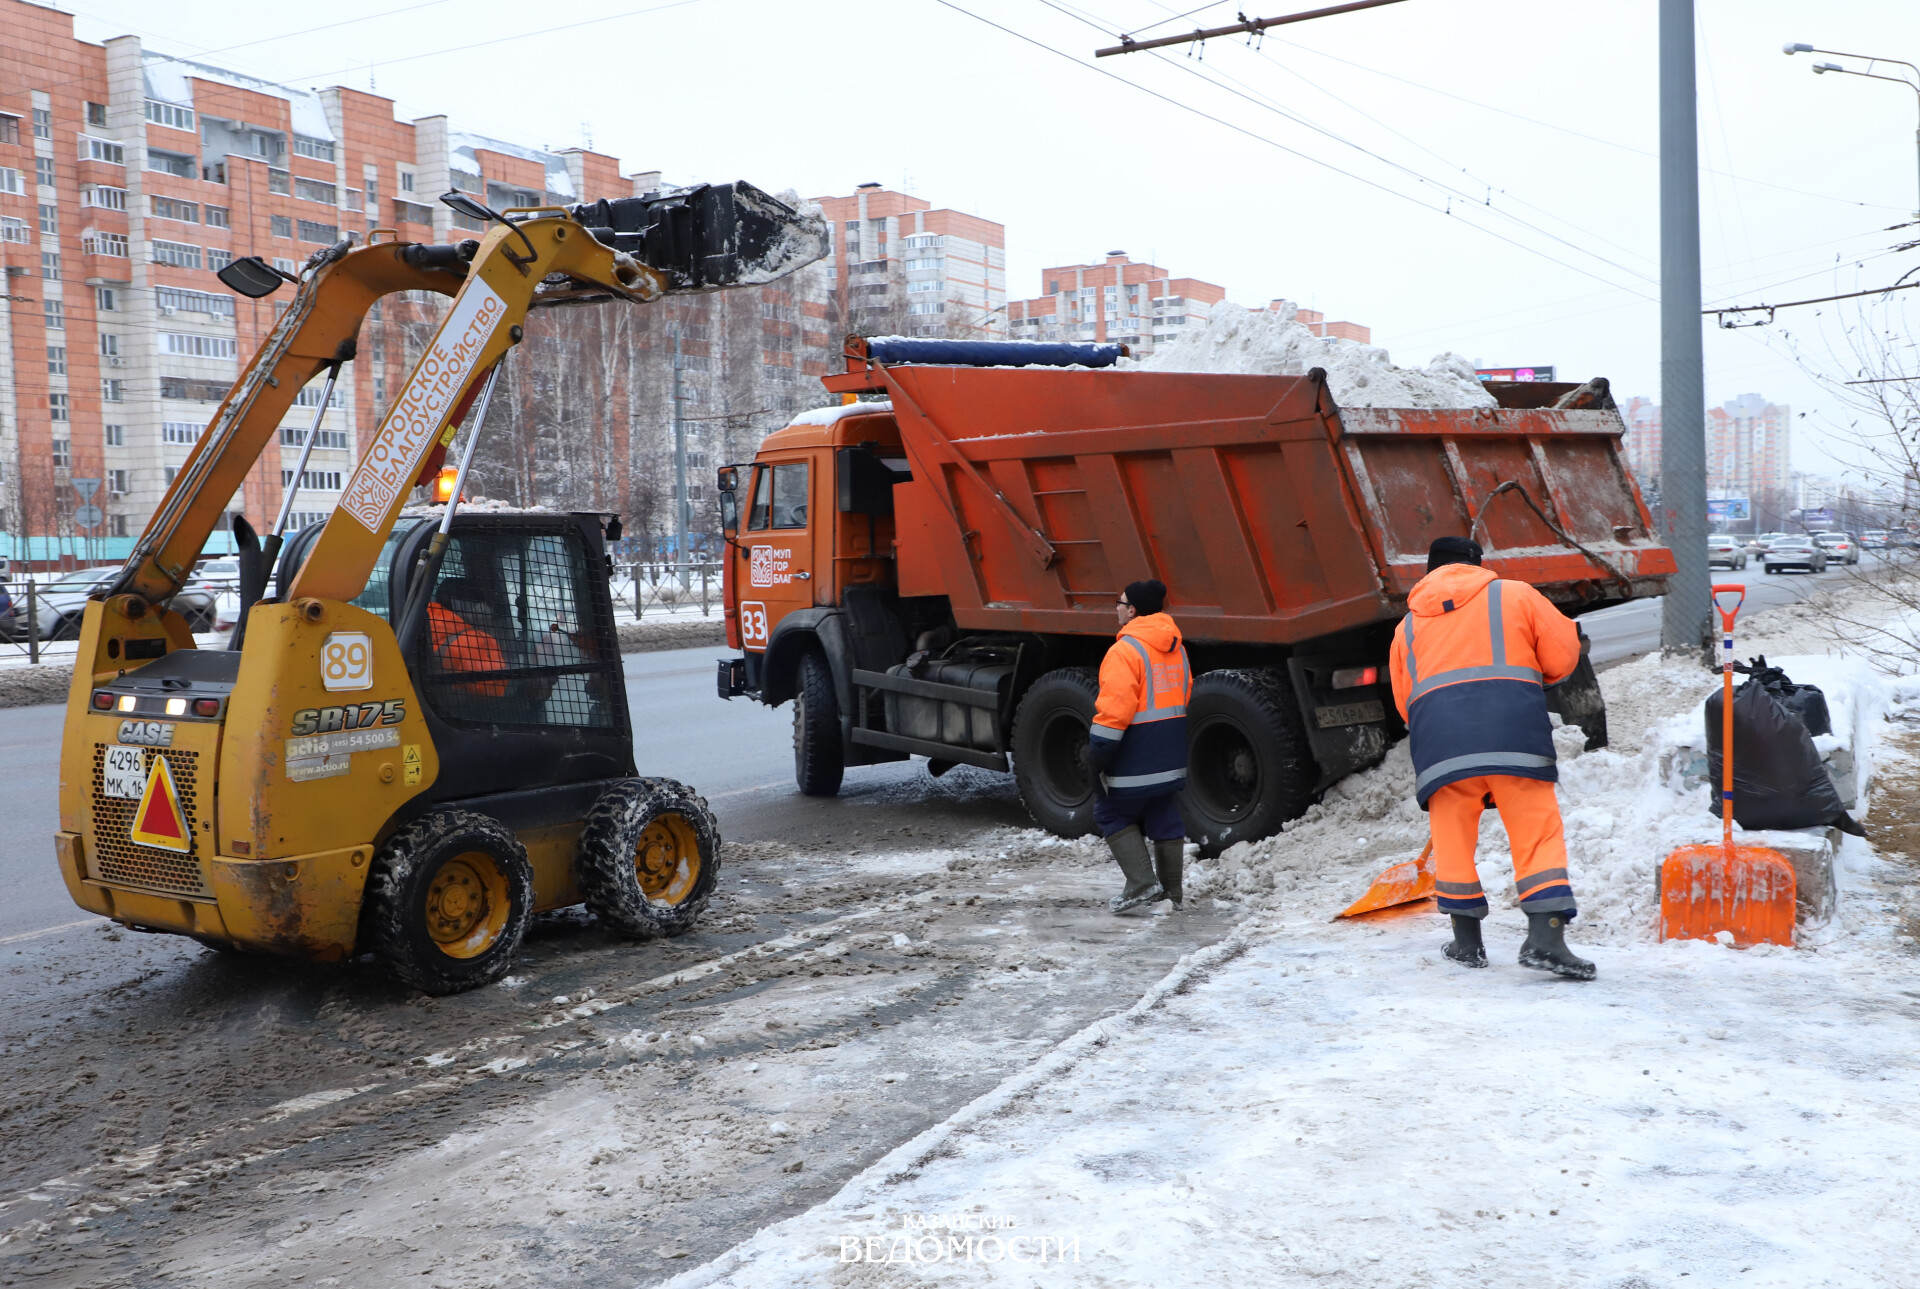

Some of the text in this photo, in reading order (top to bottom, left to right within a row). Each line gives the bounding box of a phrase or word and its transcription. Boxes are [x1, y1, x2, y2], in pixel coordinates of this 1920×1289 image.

[381, 296, 498, 487] БЛАГОУСТРОЙСТВО
[393, 305, 504, 490] муниципальное унитарное предприятие
[366, 343, 449, 474] ГОРОДСКОЕ
[773, 549, 791, 559] МУП
[773, 561, 788, 571] ГОР
[773, 574, 792, 584] БЛАГ
[743, 610, 766, 640] 33
[326, 642, 368, 680] 89
[291, 698, 406, 736] SR175
[117, 720, 176, 747] CASE
[286, 739, 329, 757] actio
[332, 739, 348, 748] (495)
[350, 736, 363, 747] 54
[365, 734, 384, 745] 500
[109, 750, 140, 771] 4296
[290, 762, 349, 775] www.actio.ru
[106, 778, 143, 795] МК 16
